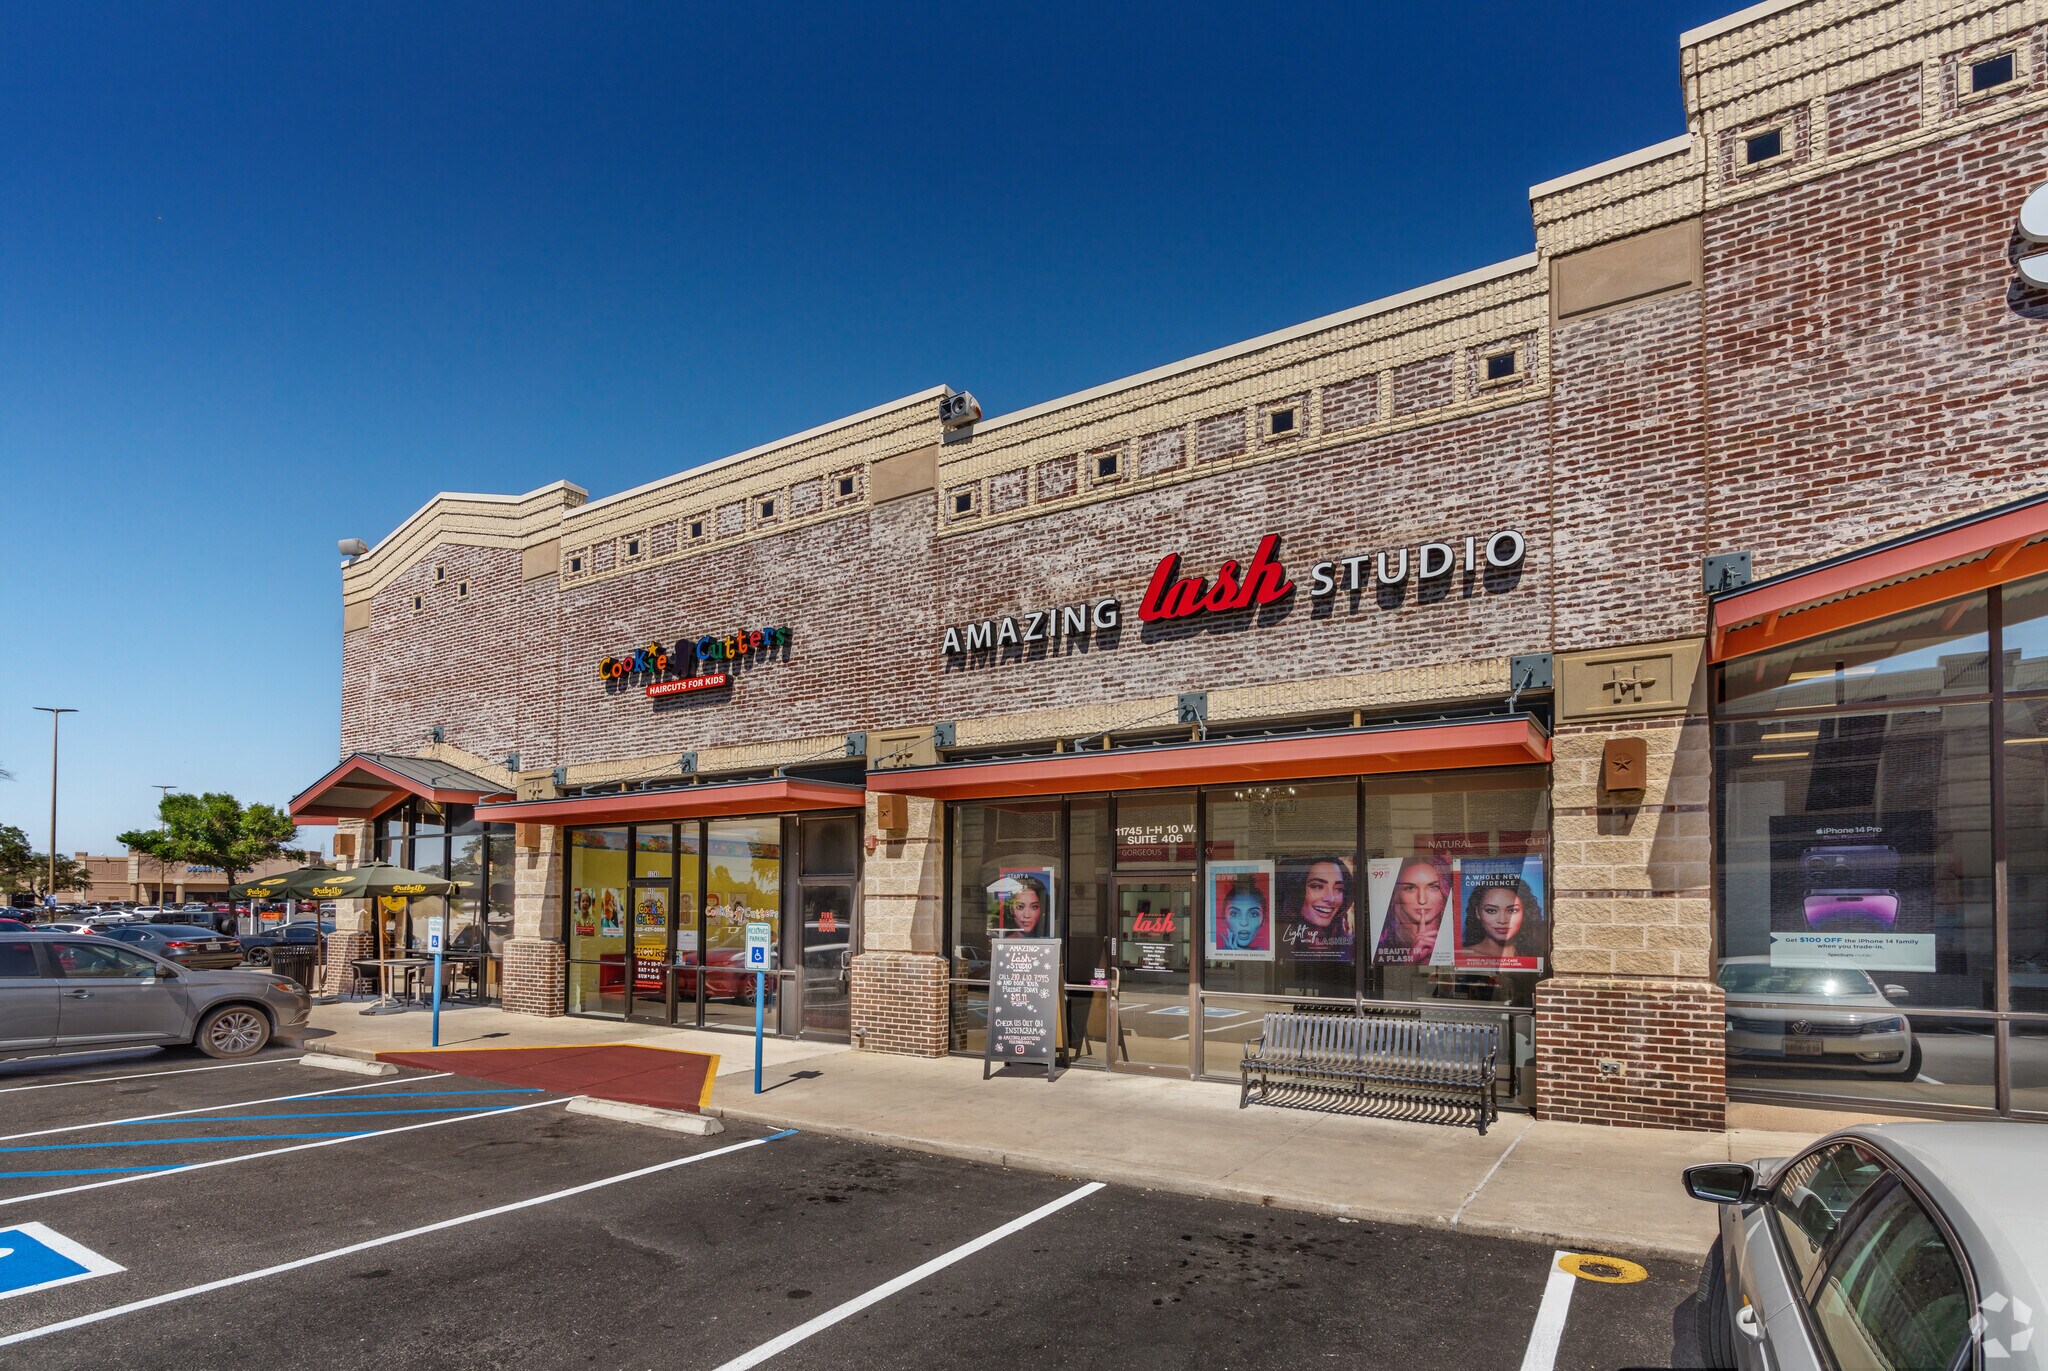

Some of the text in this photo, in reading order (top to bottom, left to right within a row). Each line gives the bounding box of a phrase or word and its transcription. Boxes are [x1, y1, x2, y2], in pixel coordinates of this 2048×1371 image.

[942, 529, 1526, 654] AMAZING lash STUDIO
[600, 626, 786, 680] Cookie Cutters
[650, 676, 724, 695] HAIRCUTS FOR KIDS
[1115, 824, 1196, 836] 11745 I-H 10 W.
[1127, 834, 1184, 845] SUITE 406
[1428, 840, 1473, 849] NATURAL
[1121, 848, 1162, 857] GORGEOUS
[247, 888, 271, 897] Potbelly
[312, 887, 343, 897] Potbelly
[392, 884, 426, 894] Potbelly
[638, 900, 664, 915] Cookie
[636, 913, 666, 925] Cutters
[1133, 912, 1176, 932] lash
[748, 927, 768, 935] RESERVED
[1282, 923, 1319, 945] Light up
[1315, 937, 1353, 945] LASHES
[637, 947, 666, 957] HOURS
[1378, 947, 1410, 955] BEAUTY
[1011, 952, 1032, 963] Lash
[1013, 1019, 1021, 1027] US
[1022, 1019, 1033, 1027] OUT
[1034, 1019, 1043, 1027] ON
